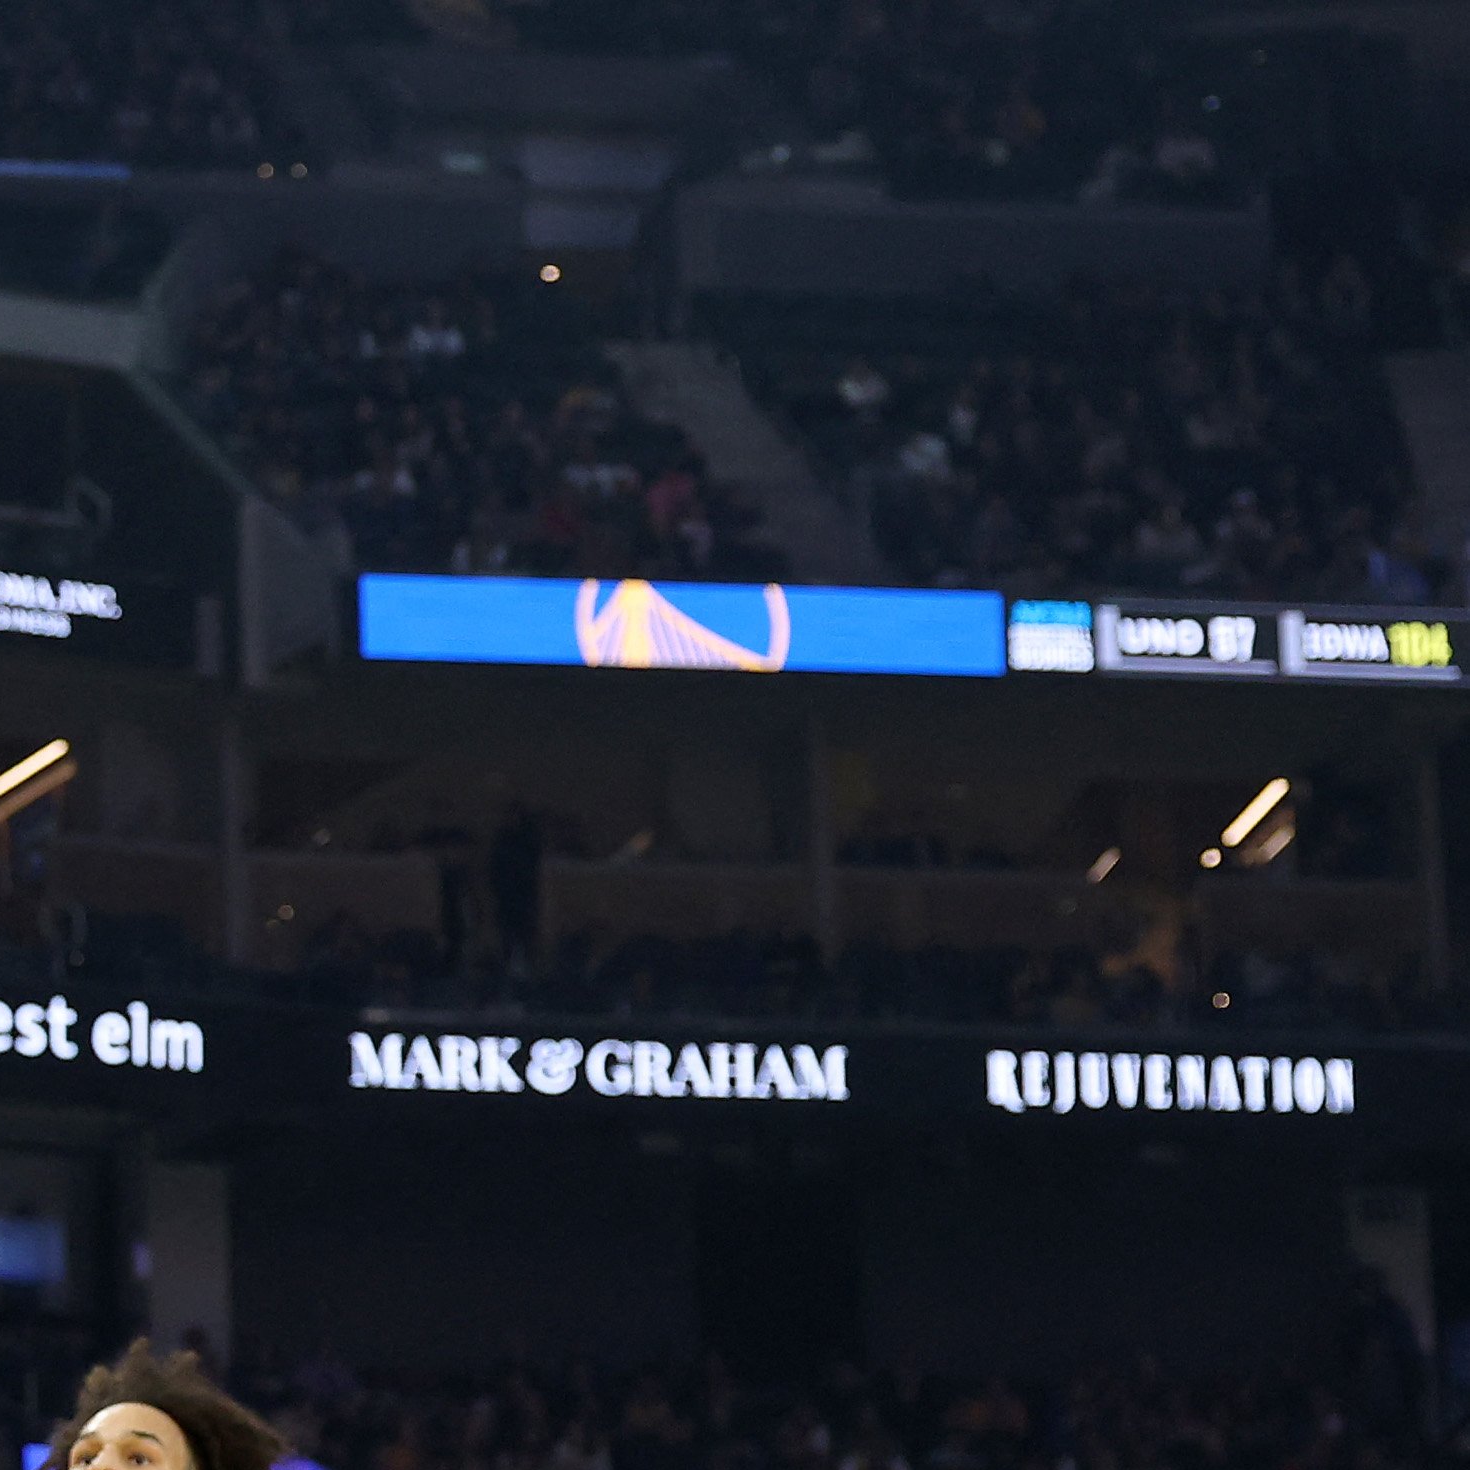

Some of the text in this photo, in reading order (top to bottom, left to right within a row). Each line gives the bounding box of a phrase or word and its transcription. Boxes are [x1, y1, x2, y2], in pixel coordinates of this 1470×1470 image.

[90, 1000, 205, 1073] elm
[348, 1031, 525, 1093] MARK
[584, 1038, 851, 1102] GRAHAM
[986, 1049, 1354, 1114] REJUVENATION
